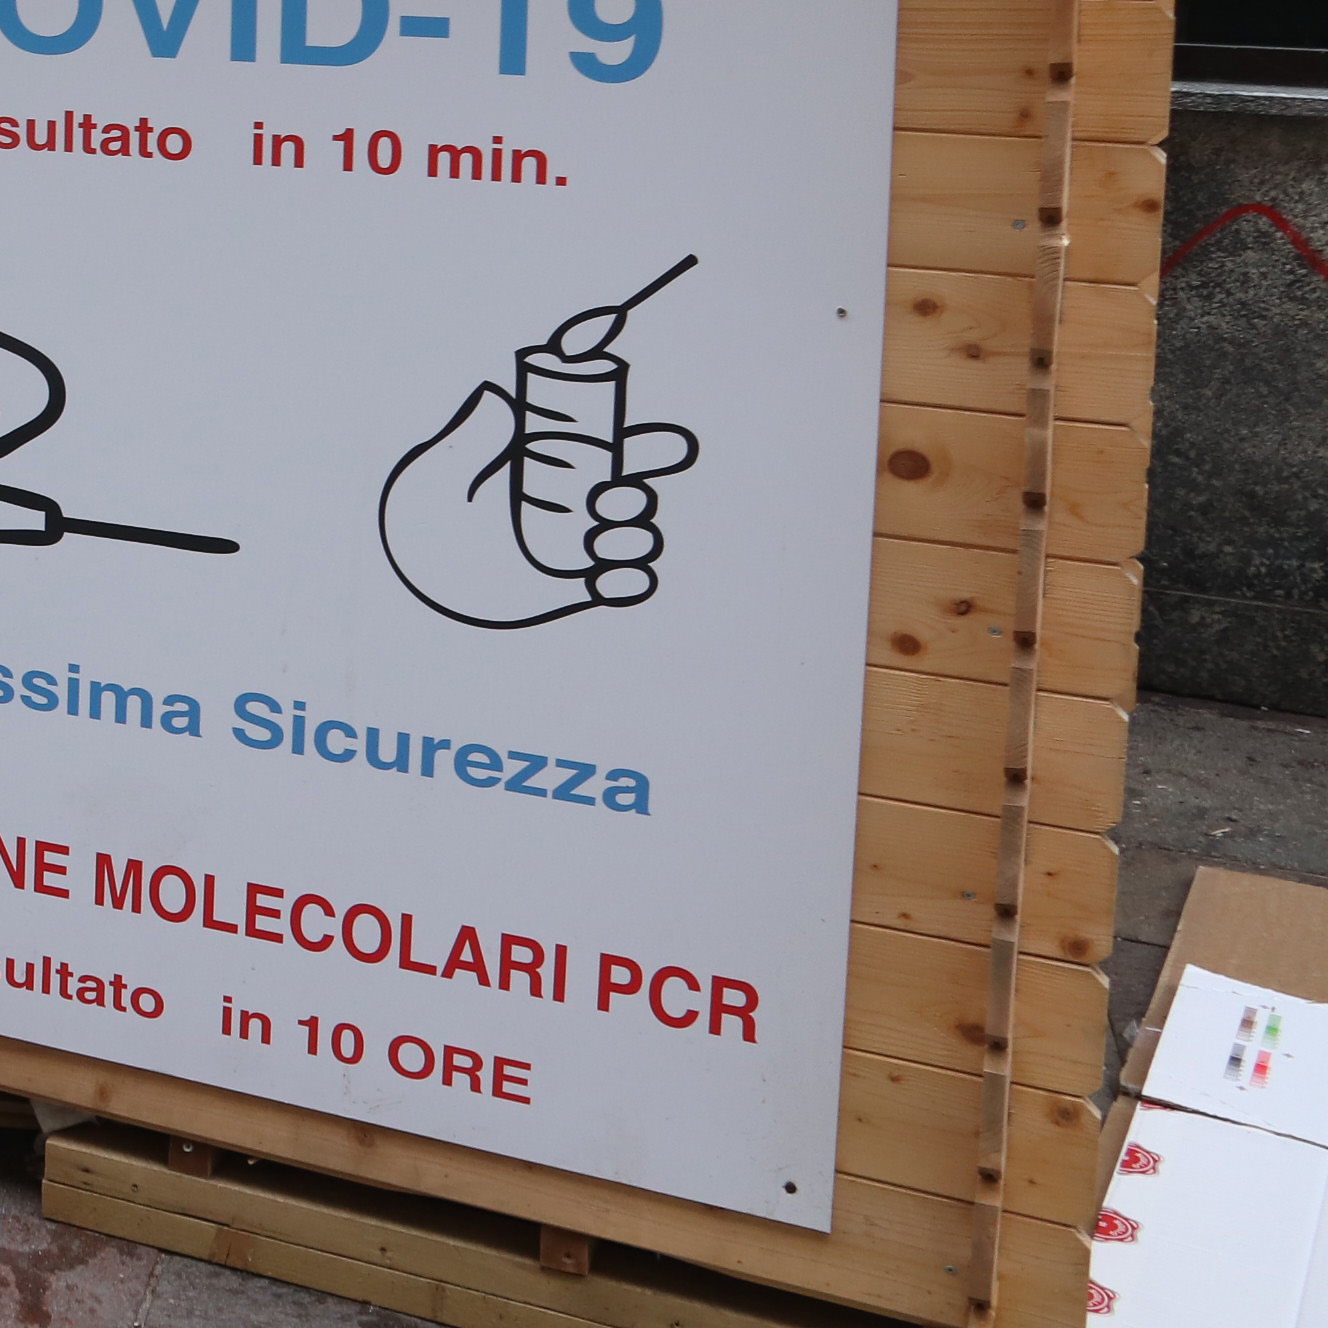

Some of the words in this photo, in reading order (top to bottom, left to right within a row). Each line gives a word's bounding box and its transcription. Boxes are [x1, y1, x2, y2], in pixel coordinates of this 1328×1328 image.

[252, 122, 305, 168] in
[332, 128, 403, 175] 10
[428, 136, 568, 187] min.
[231, 692, 651, 816] Sicurezza
[94, 852, 568, 1005] MOLECOLARI
[596, 953, 760, 1043] PCR
[221, 996, 272, 1046] in
[297, 1015, 365, 1064] 10
[387, 1034, 532, 1105] ORE
